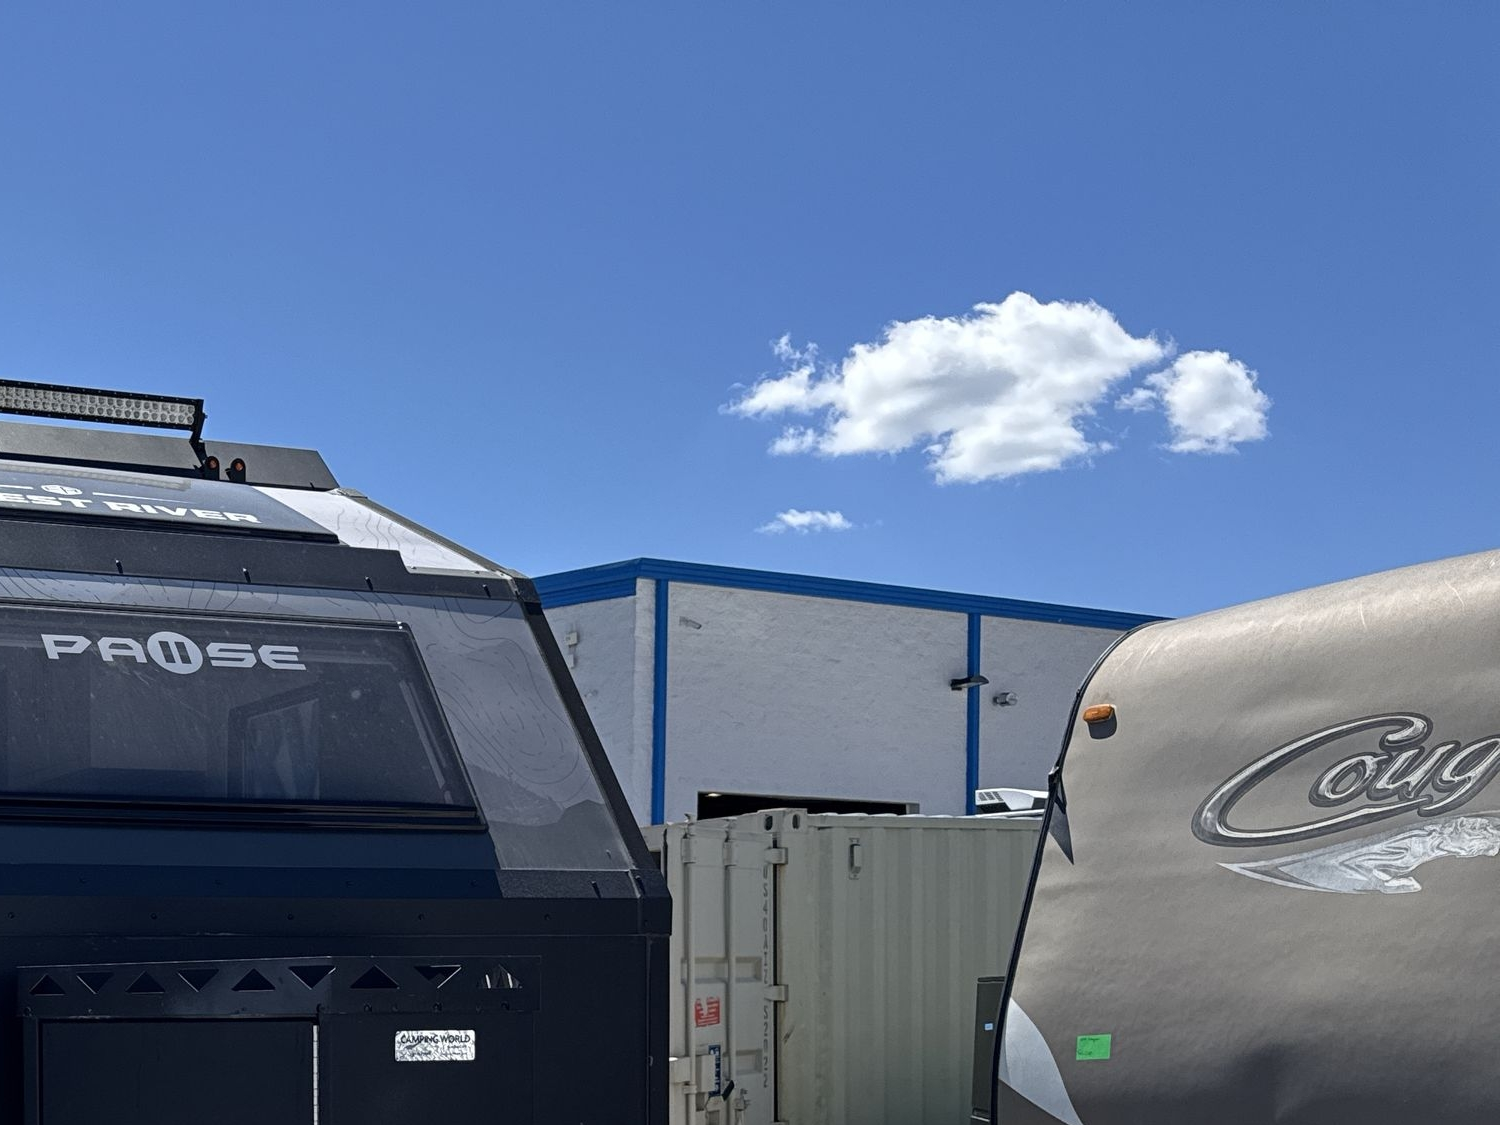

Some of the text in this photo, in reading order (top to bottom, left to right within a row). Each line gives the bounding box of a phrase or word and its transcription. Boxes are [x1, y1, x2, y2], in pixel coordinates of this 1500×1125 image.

[103, 501, 262, 524] RIVER
[400, 1033, 471, 1045] CAMPING WORLD
